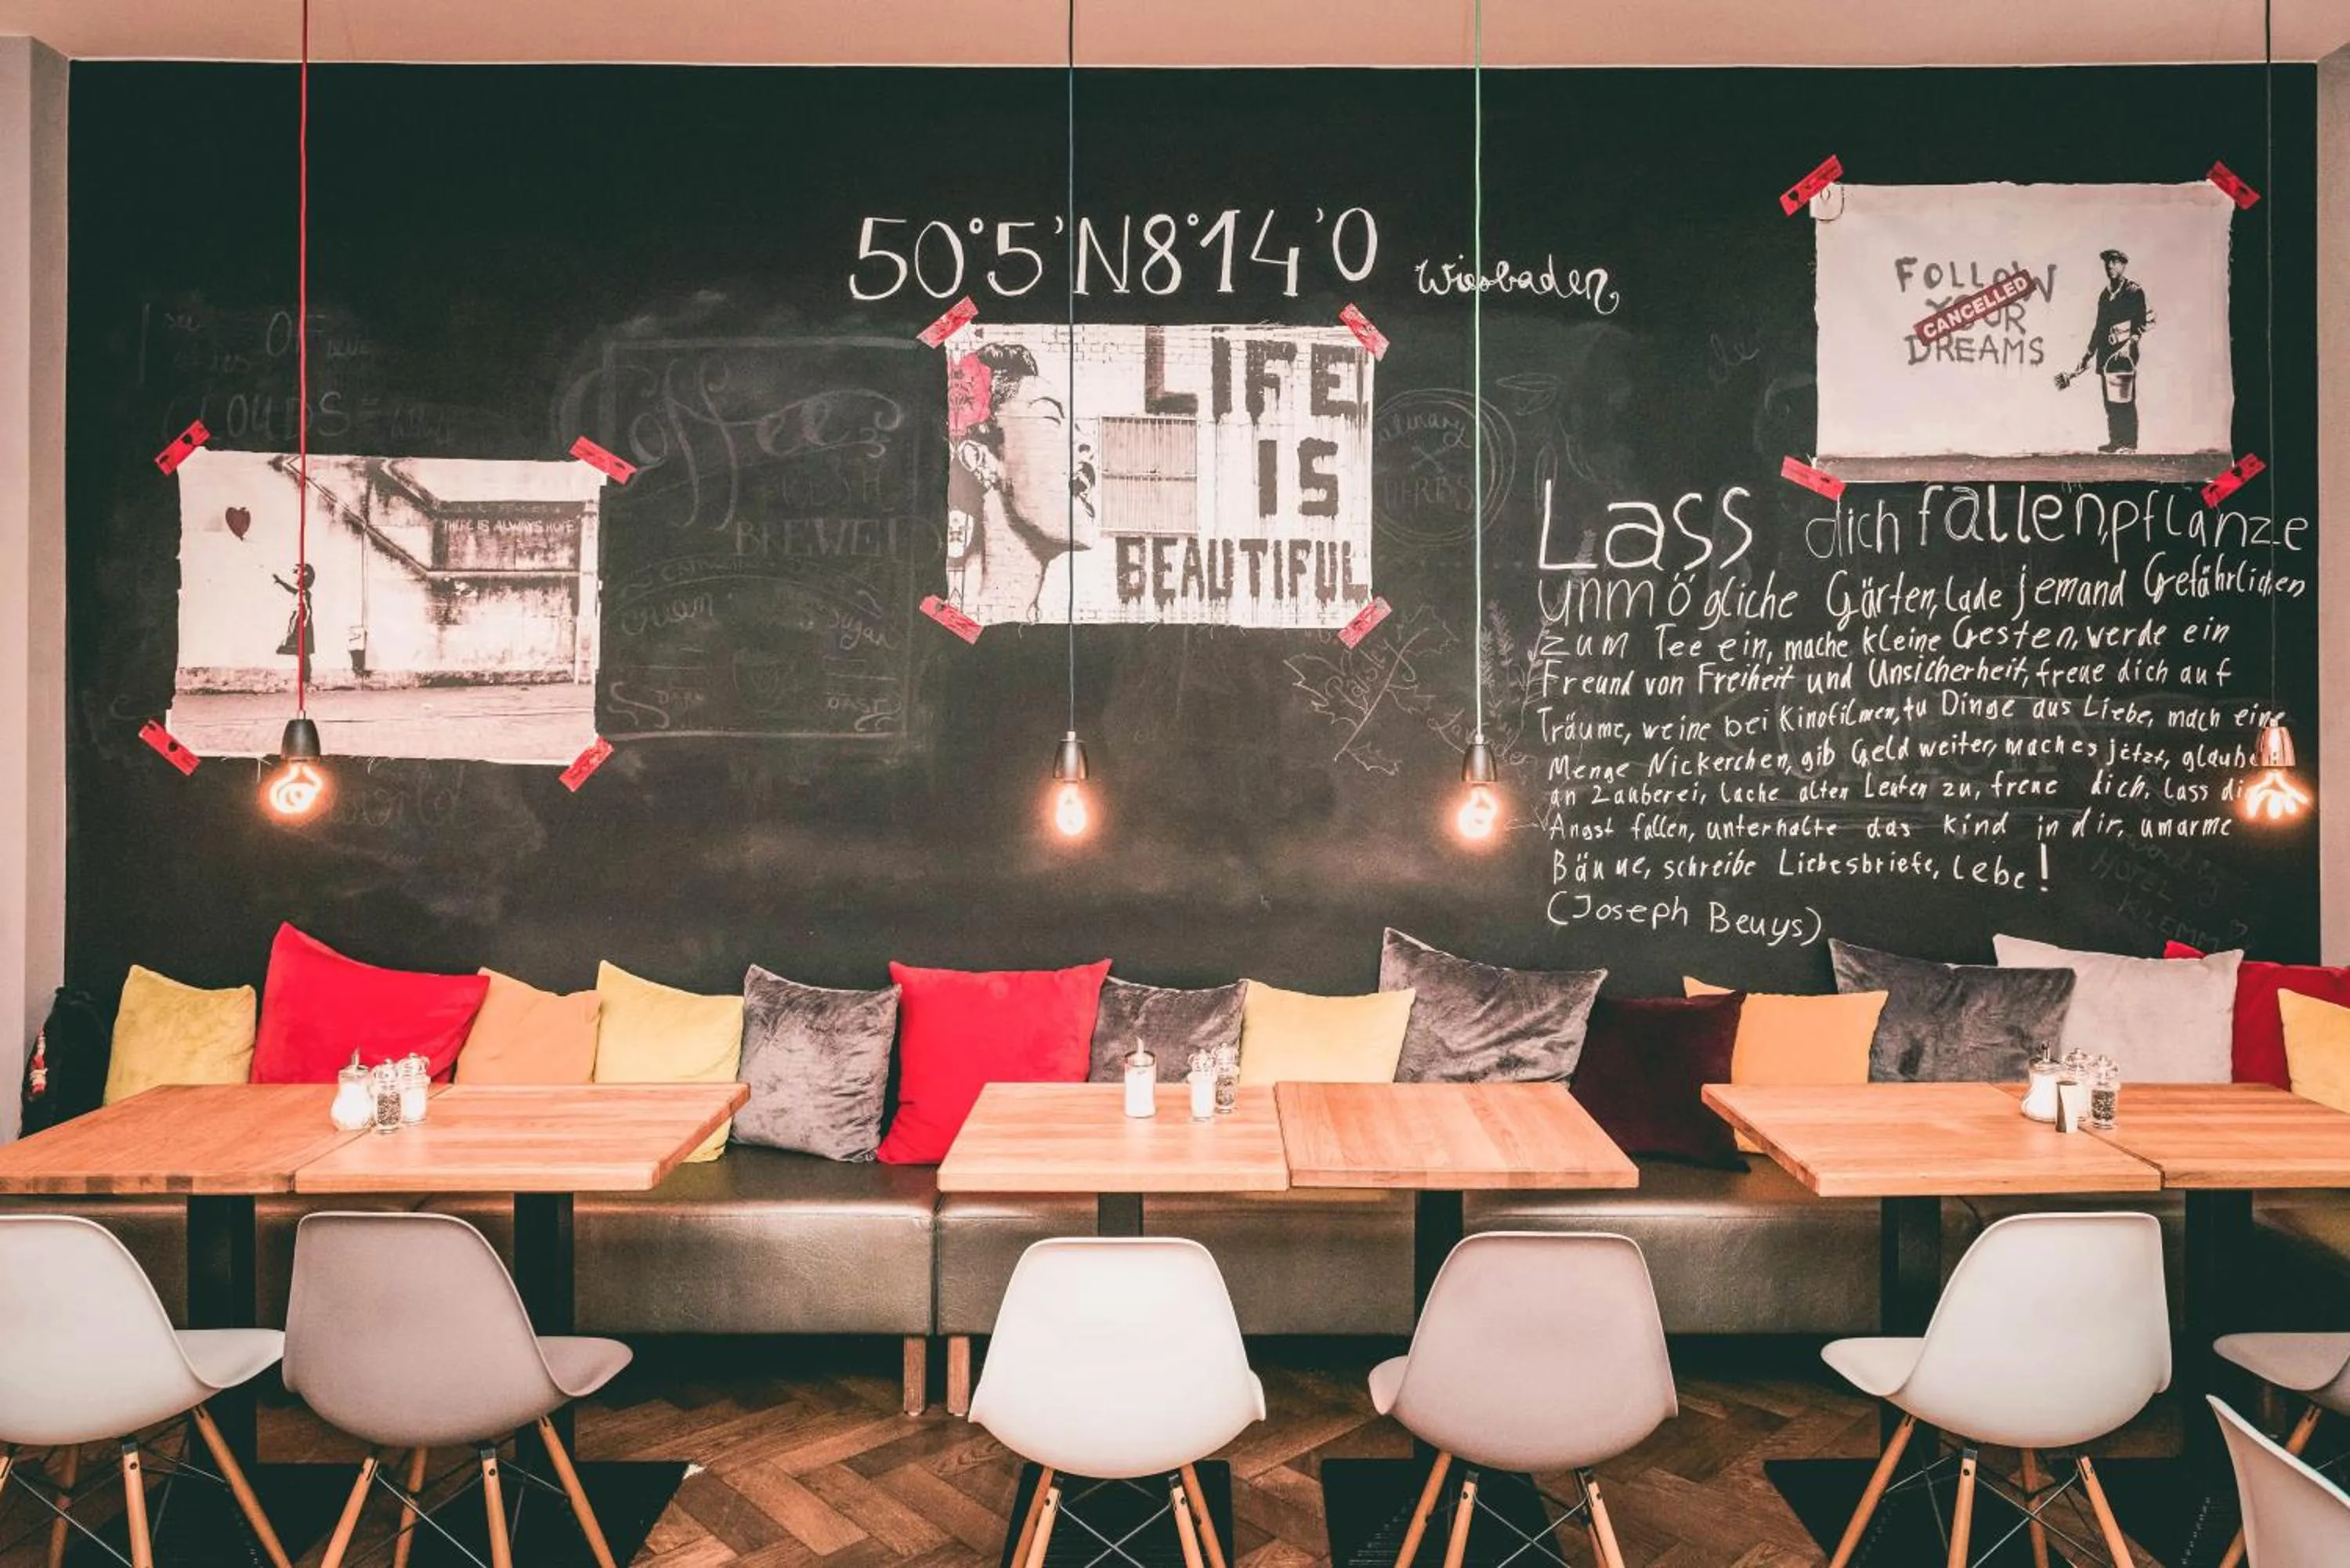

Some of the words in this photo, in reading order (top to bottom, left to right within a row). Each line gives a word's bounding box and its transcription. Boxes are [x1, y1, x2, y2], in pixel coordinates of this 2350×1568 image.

[1922, 275, 2030, 339] CANCELLED
[1144, 325, 1369, 428] LIFE
[1904, 333, 2044, 366] DREAMS
[1258, 437, 1340, 519] IS
[477, 518, 490, 531] IS
[493, 518, 544, 533] ALWAYS
[1537, 479, 1753, 571] Lass
[1805, 496, 1899, 558] dich
[1115, 537, 1368, 611] BEAUTIFUL
[2012, 564, 2127, 621] jemand
[2144, 551, 2306, 605] Gefährlichen
[1654, 623, 1702, 660] Tee
[1716, 630, 1773, 665] ein,
[1784, 630, 1849, 661] mache
[2085, 617, 2167, 649] werde
[2182, 616, 2231, 645] ein
[1542, 659, 1636, 698] Freund
[1645, 674, 1685, 696] von
[1698, 661, 1796, 695] Freiheit
[1806, 662, 1853, 695] und
[1868, 655, 2029, 688] Unsicherheit,
[2036, 656, 2106, 688] freue
[2117, 657, 2169, 685] dich
[2179, 657, 2232, 687] auf
[1536, 706, 1632, 746] Träume,
[1642, 714, 1712, 742] weine
[1724, 709, 1770, 738] bei
[1779, 697, 1900, 732] Kinofilmen,
[1903, 695, 1927, 722] tu
[1941, 689, 2016, 720] Dinge
[2032, 698, 2072, 719] aus
[2083, 693, 2154, 728] Liebe,
[2167, 706, 2221, 732] mach
[1548, 753, 1630, 783] Menge
[1647, 746, 1792, 779] Nickerchen,
[1801, 736, 1835, 772] gib
[1851, 734, 1910, 768] Geld
[1918, 730, 1998, 759] weiter,
[1549, 787, 1576, 808] an
[1591, 781, 1708, 806] Zauberei,
[1799, 779, 1849, 803] alten
[1864, 771, 1929, 800] Leuten
[1942, 782, 1981, 802] zu,
[1990, 769, 2059, 798] freue
[2221, 778, 2246, 802] di
[1549, 811, 1614, 841] Angst
[1629, 811, 1696, 844] fallen,
[1706, 814, 1838, 841] unterhalte
[1867, 815, 1911, 840] das
[2037, 814, 2060, 840] in
[2140, 816, 2232, 839] umarme
[1663, 847, 1758, 880] schreibe
[1778, 847, 1940, 880] Liebesbriefe,
[1546, 890, 1688, 930] (Joseph
[1709, 900, 1823, 947] Beuys)
